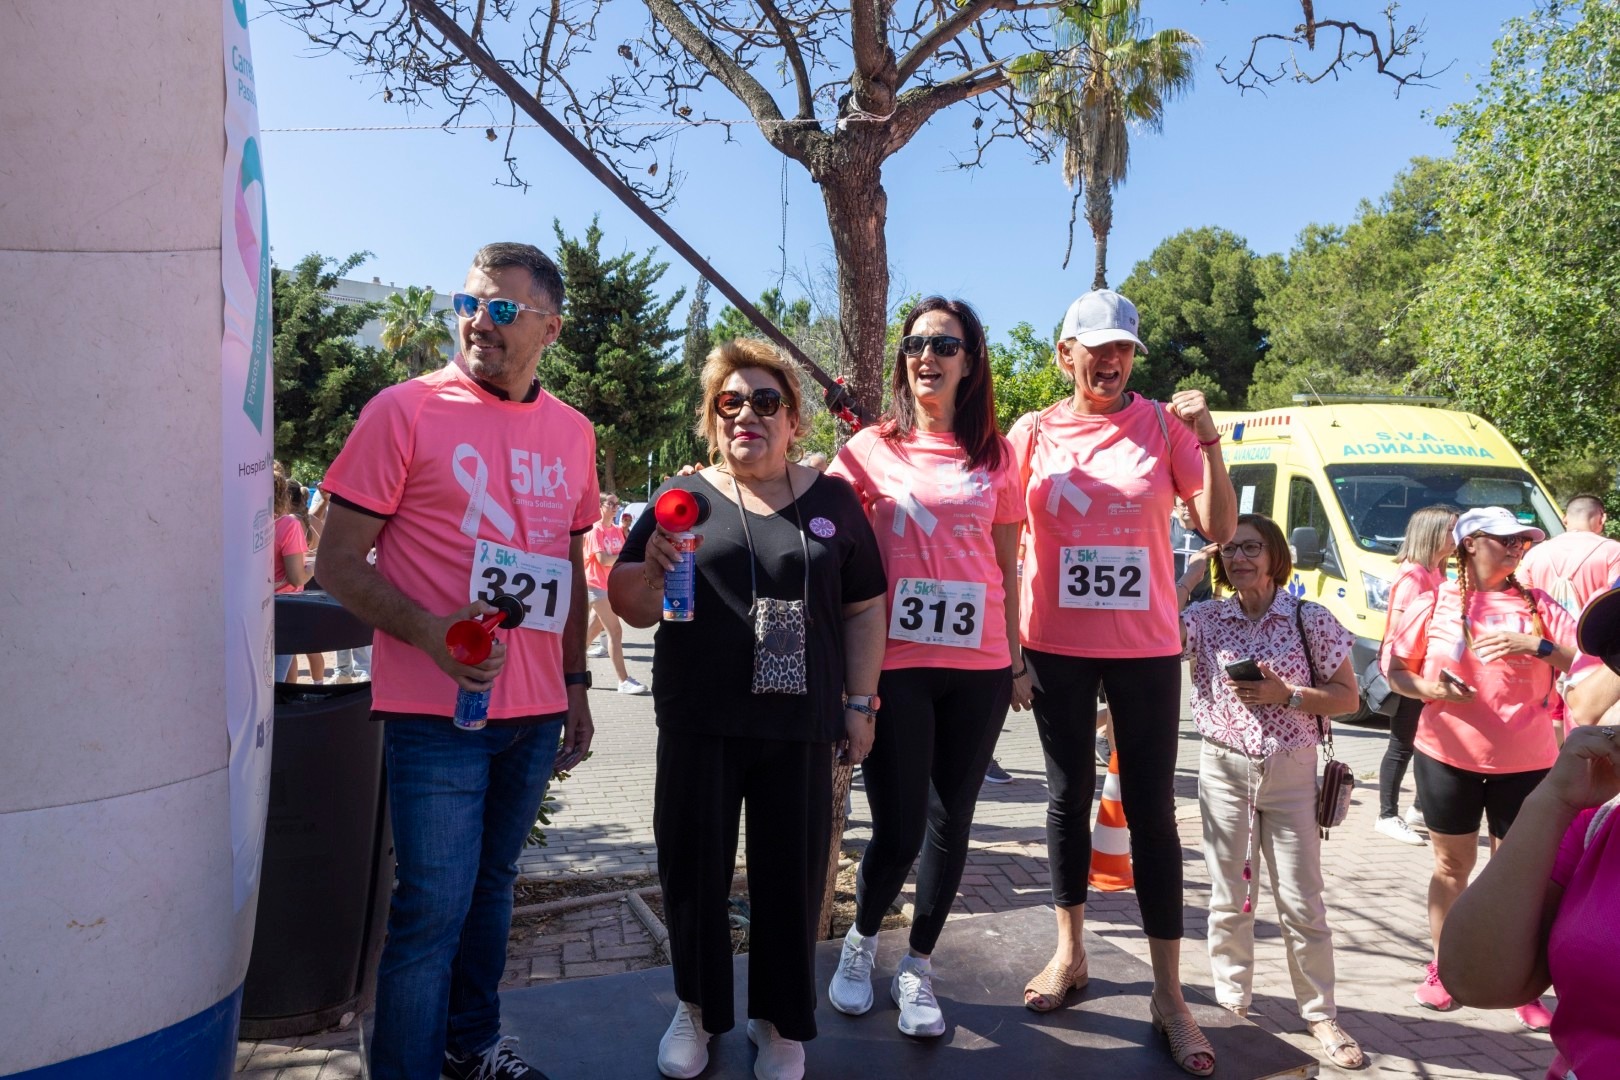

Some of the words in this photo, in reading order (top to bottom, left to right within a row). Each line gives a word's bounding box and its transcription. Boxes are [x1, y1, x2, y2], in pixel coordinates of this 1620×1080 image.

[247, 358, 260, 405] Pasos
[259, 257, 268, 320] cuentan
[1234, 447, 1271, 460] AVANZADO
[239, 456, 267, 477] Hospital
[510, 448, 556, 498] 5k
[535, 500, 563, 510] Solidaria
[255, 530, 264, 550] 25
[494, 548, 513, 567] 5k
[1077, 549, 1093, 563] 5k
[913, 581, 929, 595] 5k
[1067, 564, 1142, 598] 352
[478, 567, 559, 617] 321
[899, 596, 976, 636] 313
